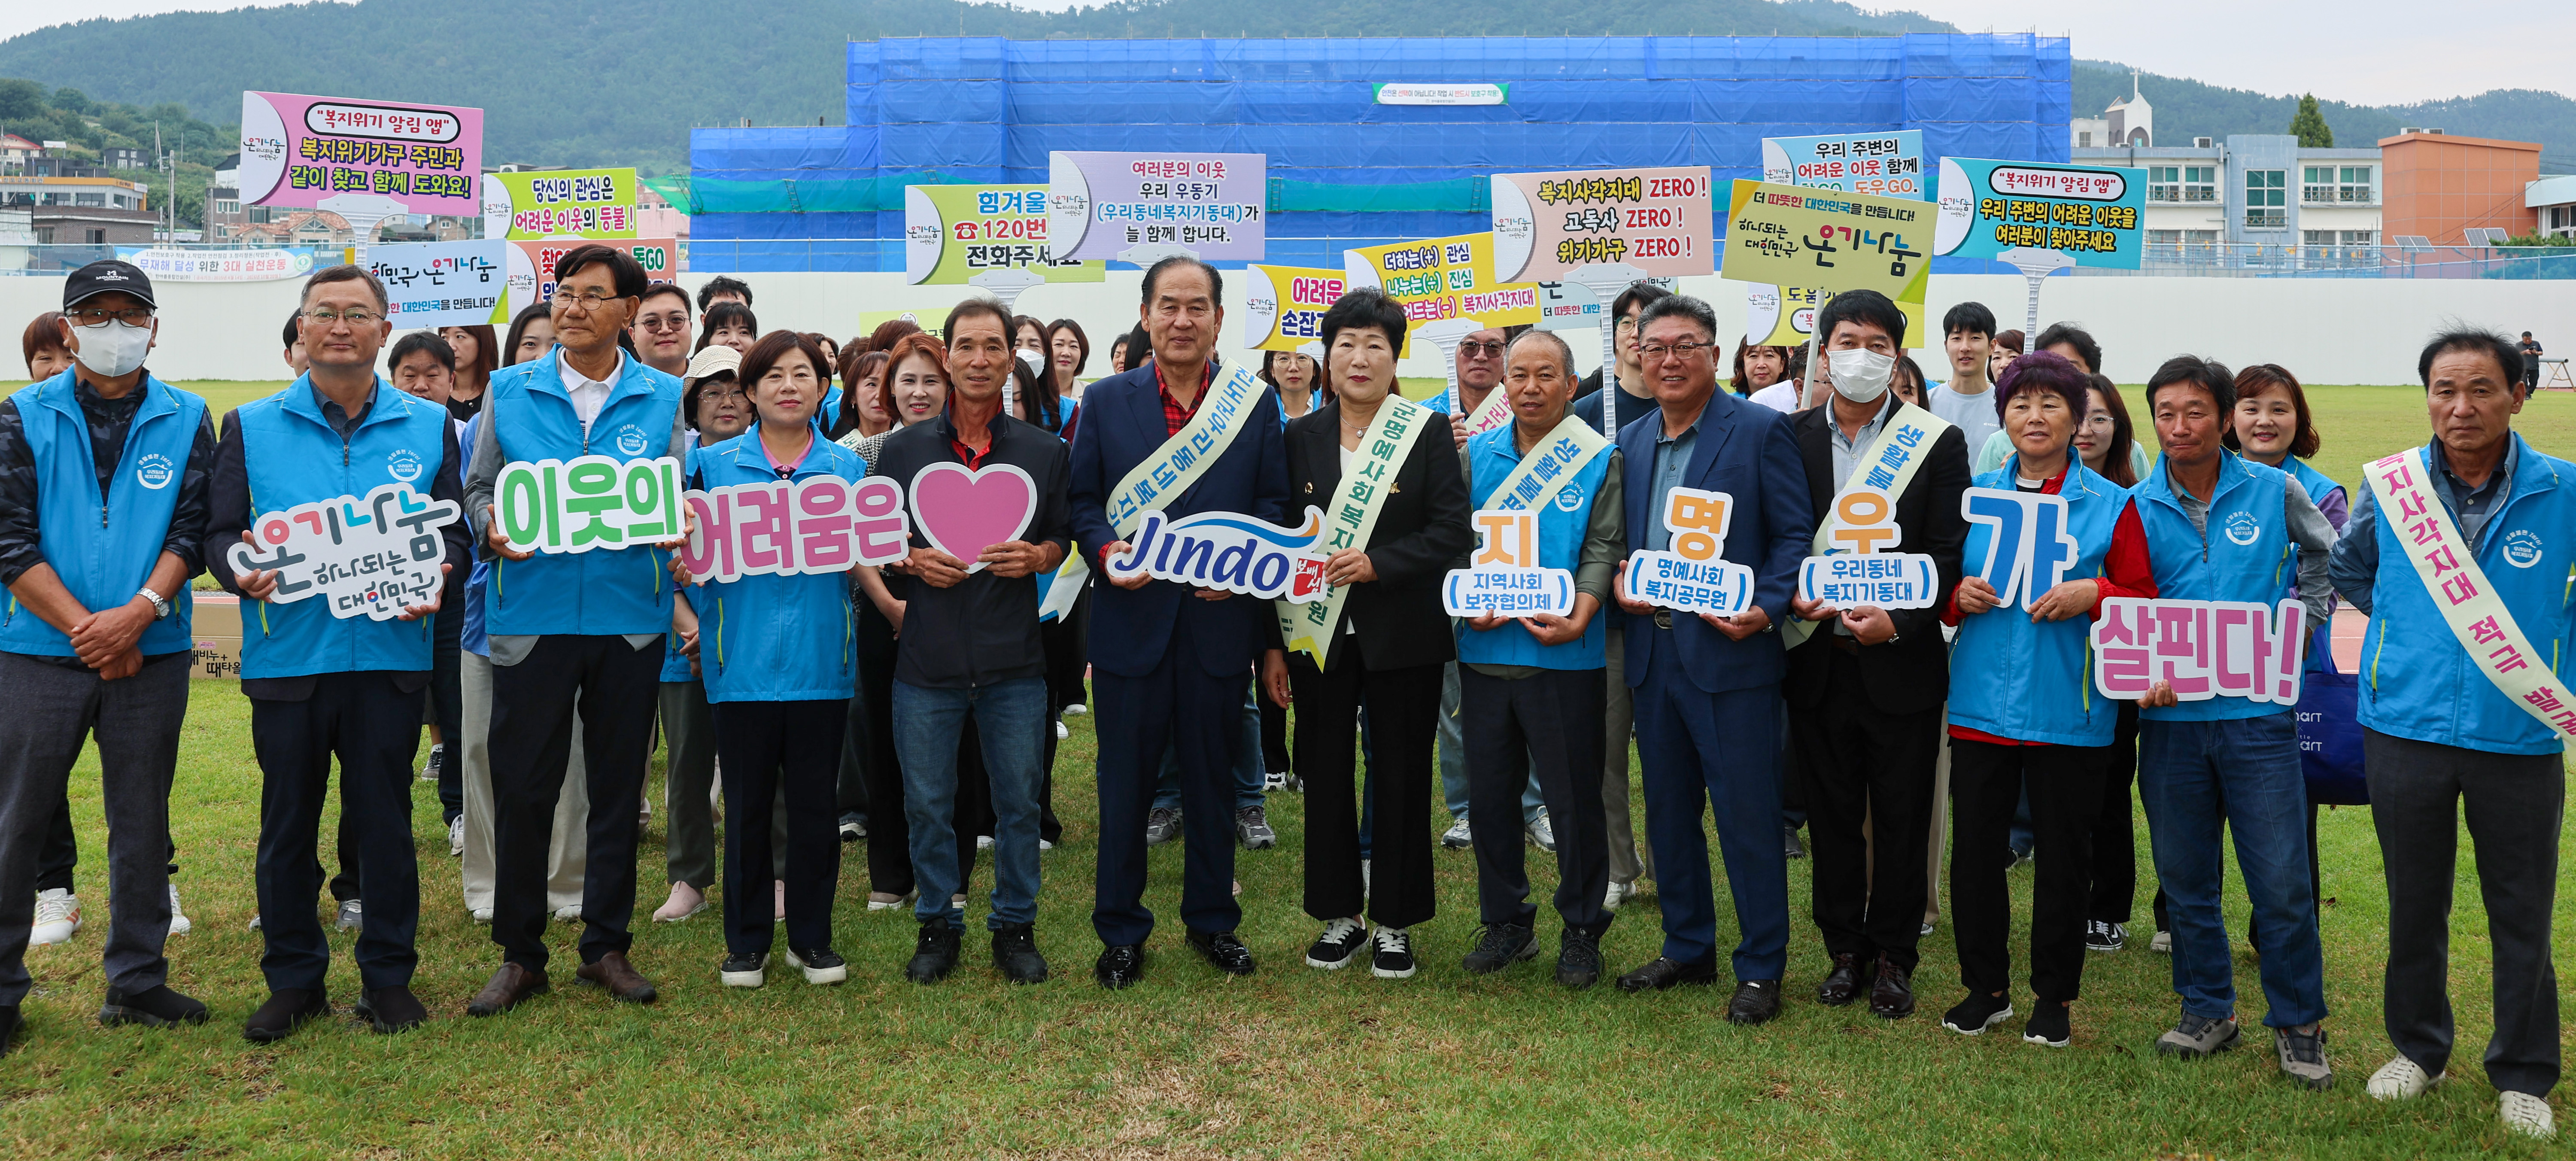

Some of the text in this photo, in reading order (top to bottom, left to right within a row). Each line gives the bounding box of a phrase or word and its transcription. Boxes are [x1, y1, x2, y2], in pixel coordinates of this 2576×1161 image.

[317, 110, 450, 134] "복지위기 알림 앱"
[243, 138, 285, 153] 온기나눔
[300, 137, 463, 170] 복지위기가구 주민과
[1816, 139, 1898, 158] 우리 주변의
[1133, 161, 1226, 179] 여러분의 이웃
[1798, 158, 1918, 179] 어려운 이웃 함께
[291, 166, 471, 199] 같이 찾고 함께 도와요!
[533, 176, 614, 203] 당신의 관심은
[1140, 182, 1218, 200] 우리 우동기
[1538, 176, 1641, 206] 복지사각지대
[1649, 178, 1695, 198] ZERO
[1999, 172, 2116, 194] "복지위기 알림 앱"
[1051, 196, 1088, 209] 온기나눔
[1097, 204, 1259, 223] (우리동네복지기동대)가
[1754, 191, 1915, 222] 더 따뜻한 대한민국을 만듭니다!
[1939, 198, 1972, 211] 온기나눔
[1980, 198, 2137, 229] 우리 주변의 어려운 이웃을
[515, 208, 554, 233] 어려운
[558, 208, 596, 231] 이웃의
[907, 226, 941, 239] 온기나눔
[983, 219, 1046, 240] 120번
[1495, 217, 1531, 232] 온기나눔
[1563, 207, 1619, 233] 고독사
[1626, 208, 1672, 228] ZERO
[1739, 218, 1788, 240] 하나되는
[1126, 225, 1230, 243] 늘 함께 합니다.
[1996, 225, 2117, 252] 여러분이 찾아주세요
[1383, 242, 1470, 270] 더하는(+) 관심
[1557, 237, 1627, 263] 위기가구
[1634, 237, 1680, 258] ZERO
[1745, 237, 1799, 258] 대한민국
[1803, 225, 1922, 277] 온기나눔
[140, 259, 170, 271] 무재해
[175, 260, 194, 272] 달성
[199, 261, 219, 272] 위한
[224, 260, 241, 272] 3대
[245, 258, 286, 271] 실천운동
[423, 256, 497, 285] 온기나눔
[1293, 278, 1343, 305] 어려운
[1449, 268, 1473, 290] 진심
[402, 299, 450, 313] 대한민국을
[453, 297, 495, 310] 만듭니다!
[1247, 299, 1276, 310] 온기나눔
[1464, 289, 1534, 314] 복지사각지대
[1544, 305, 1581, 316] 더 따뜻한
[502, 462, 677, 547] 이웃의
[679, 482, 902, 576] 어려움은
[1670, 495, 1725, 561] 명
[1835, 492, 1893, 554] 우
[237, 490, 453, 595] 온기나눔
[1114, 517, 1290, 591] Jindo
[1478, 516, 1531, 567] 지
[1969, 495, 2068, 605] 가
[313, 550, 407, 585] 하나되는
[1657, 558, 1724, 586] 명예사회
[1832, 559, 1902, 579] 우리동네
[338, 572, 434, 613] 대한민국
[1473, 573, 1542, 590] 지역사회
[1823, 582, 1912, 602] 복지기동대
[1465, 594, 1551, 610] 보장협의체
[1645, 580, 1727, 610] 복지공무원
[2099, 605, 2300, 699] 살핀다!
